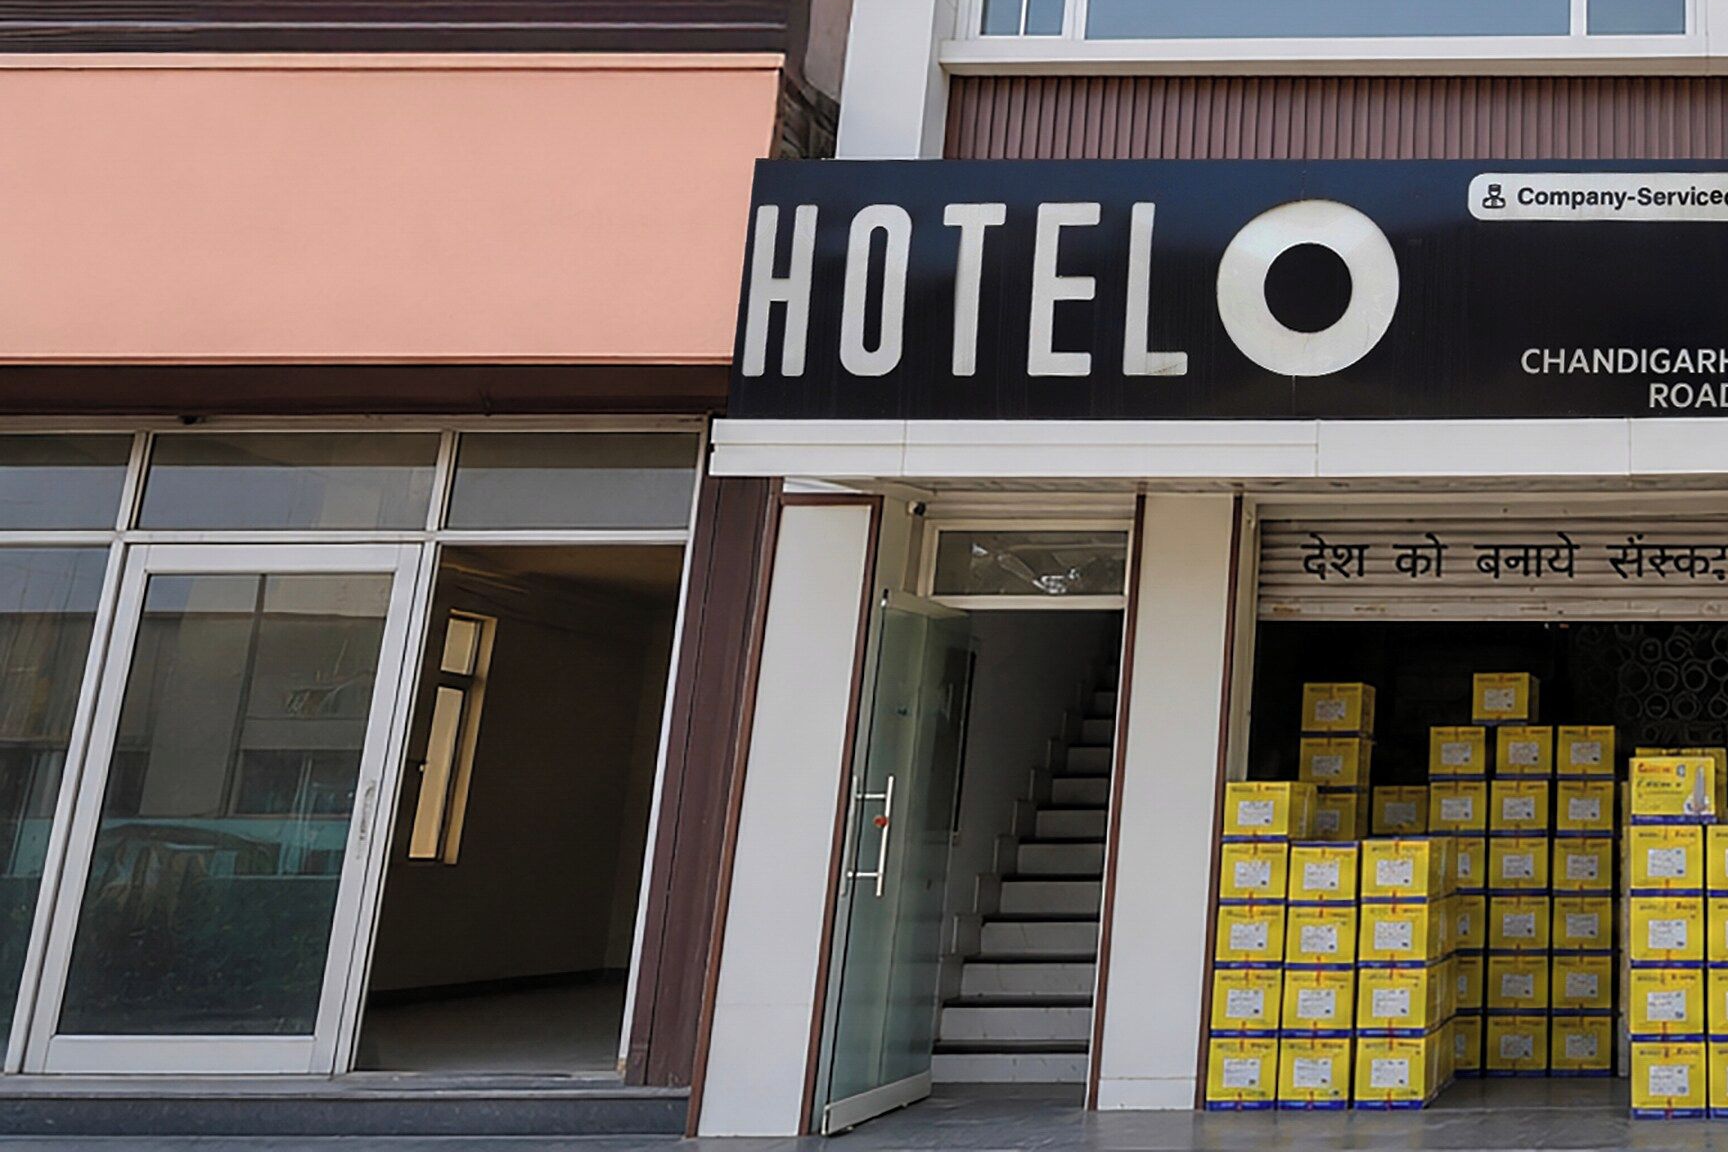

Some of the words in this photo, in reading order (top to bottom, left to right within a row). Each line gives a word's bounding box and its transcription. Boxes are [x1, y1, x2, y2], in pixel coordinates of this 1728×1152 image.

[742, 202, 1188, 377] HOTEL
[1216, 199, 1400, 377] O
[1300, 532, 1370, 580] देश
[1392, 532, 1448, 578] को
[1473, 531, 1581, 579] बनाये
